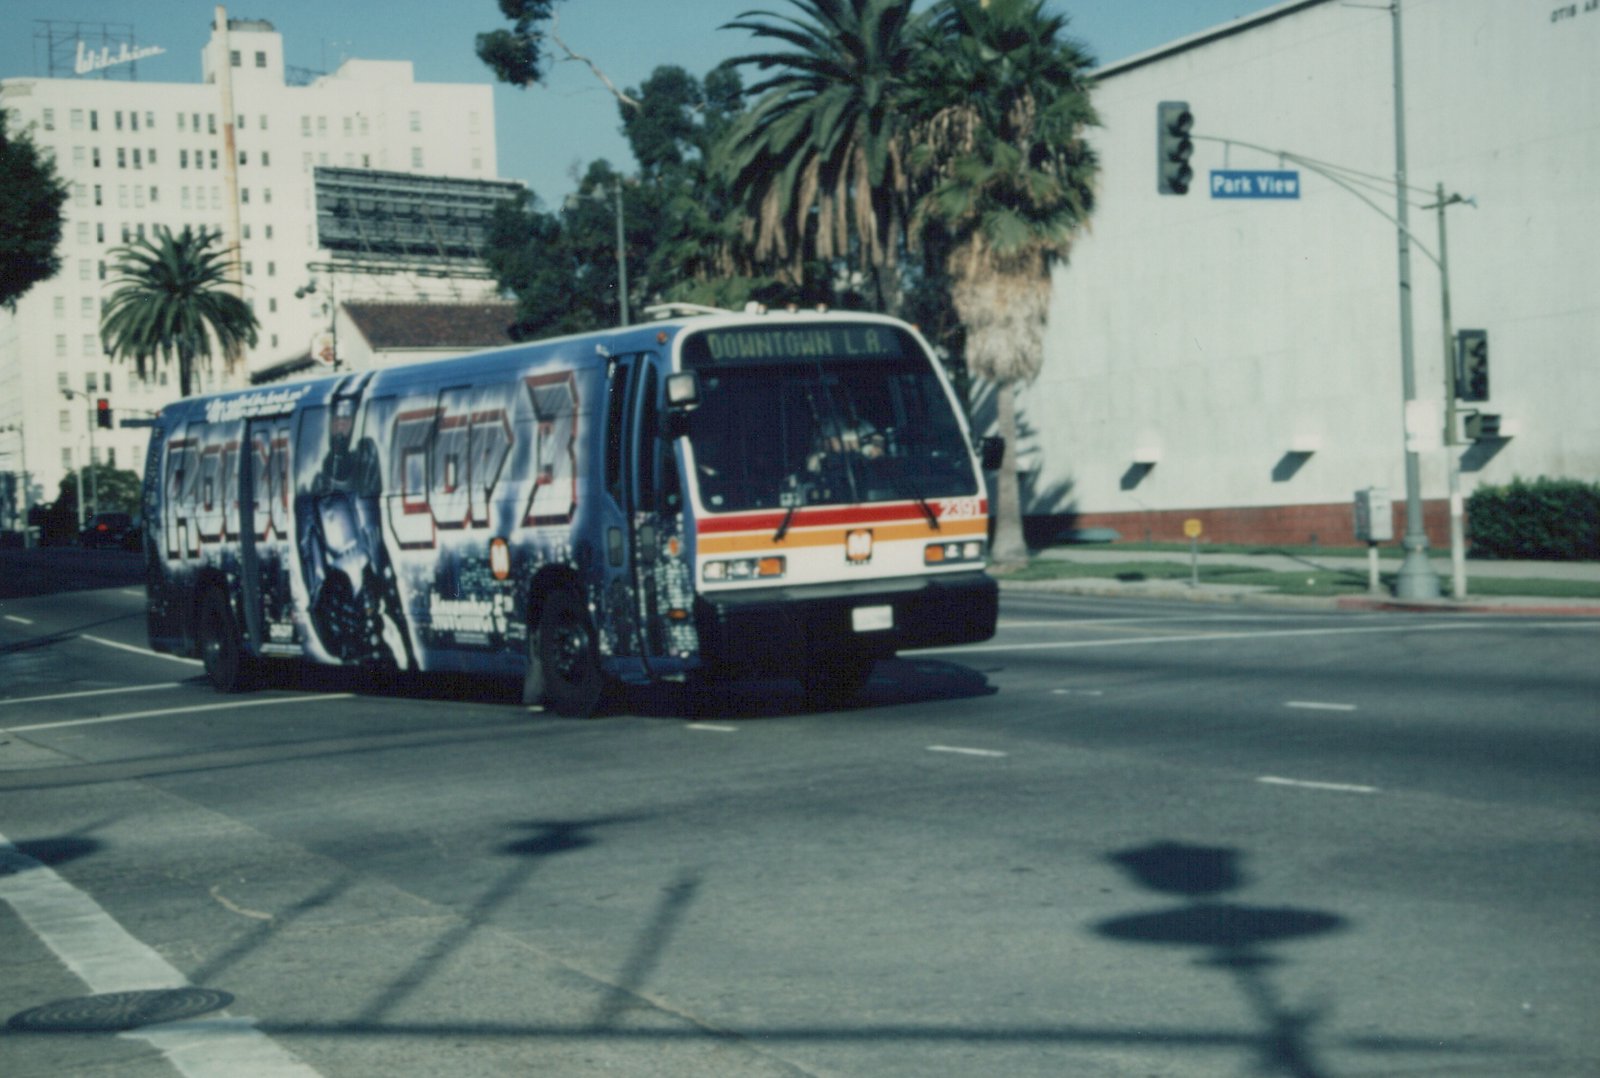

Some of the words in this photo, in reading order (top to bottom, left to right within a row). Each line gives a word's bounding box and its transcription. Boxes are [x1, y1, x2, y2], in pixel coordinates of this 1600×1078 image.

[1213, 175, 1252, 193] Park
[1257, 176, 1296, 193] View
[707, 331, 834, 359] DOWNTOWN
[939, 499, 980, 519] 2391
